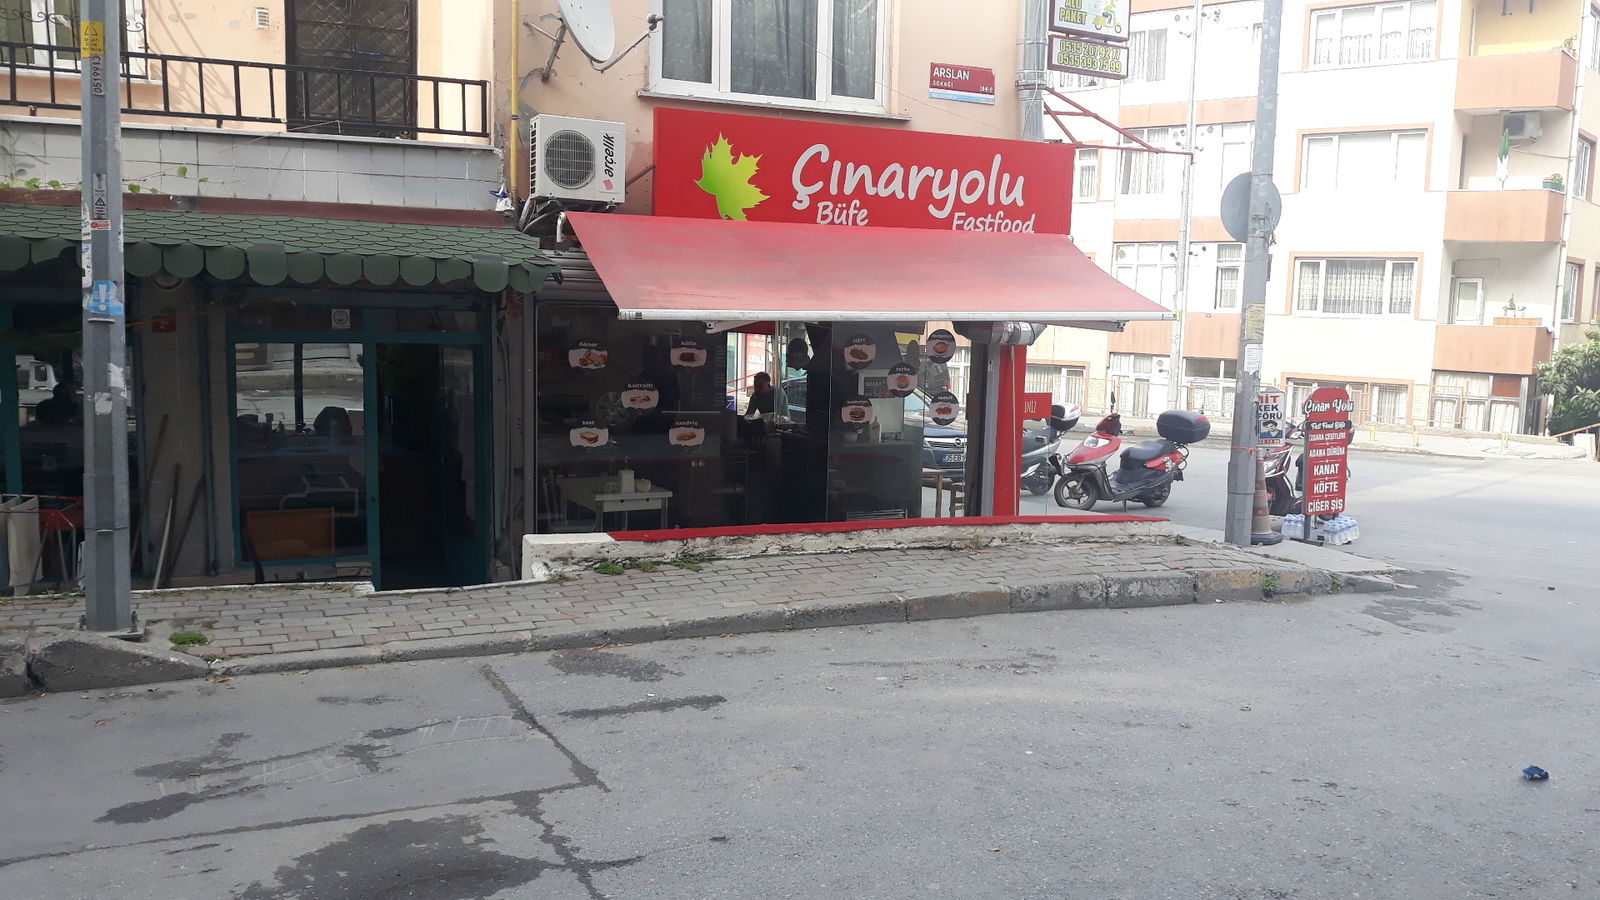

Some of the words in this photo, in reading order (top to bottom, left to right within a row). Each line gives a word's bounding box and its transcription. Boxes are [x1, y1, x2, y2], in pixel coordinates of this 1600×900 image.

[1059, 8, 1088, 25] PAKET
[1060, 40, 1083, 55] 0535
[1099, 46, 1112, 60] 92
[1057, 53, 1081, 67] 0535
[1081, 56, 1098, 69] 393
[1110, 60, 1122, 74] 99
[933, 67, 970, 80] ARSLAN
[603, 133, 617, 178] arçelik
[791, 143, 1026, 219] Çınaryolu
[816, 199, 869, 226] Büfe
[952, 210, 1036, 234] Fastfood
[1309, 448, 1326, 458] ADANA
[1313, 463, 1340, 476] KANAT
[1313, 480, 1339, 494] KÖFTE
[1308, 499, 1330, 513] CİĞER
[1331, 497, 1343, 512] ŞİŞ
